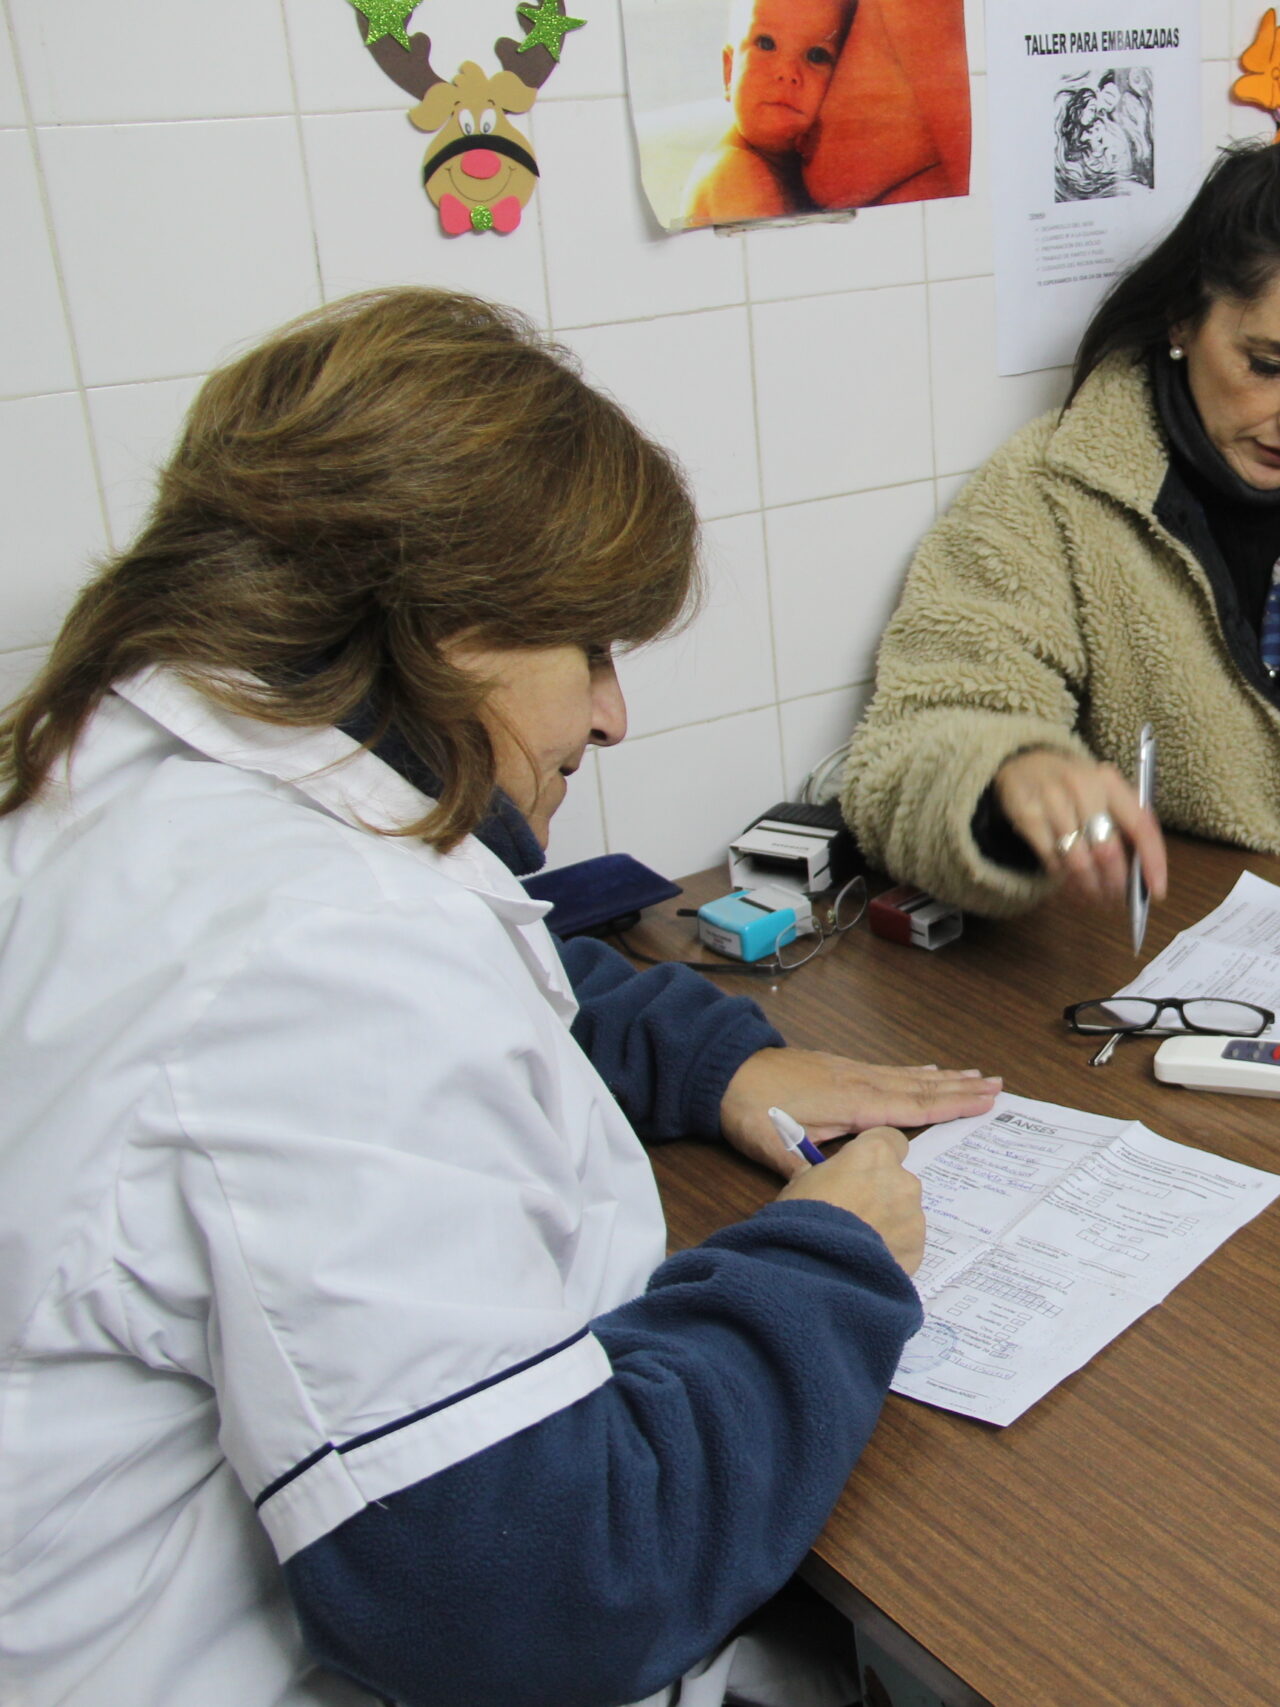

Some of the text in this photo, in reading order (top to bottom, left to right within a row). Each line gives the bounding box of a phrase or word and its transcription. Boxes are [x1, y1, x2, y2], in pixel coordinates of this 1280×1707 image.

[1024, 27, 1180, 56] TALLER PARA EMBARAZADAS
[1010, 1119, 1058, 1135] ANSES
